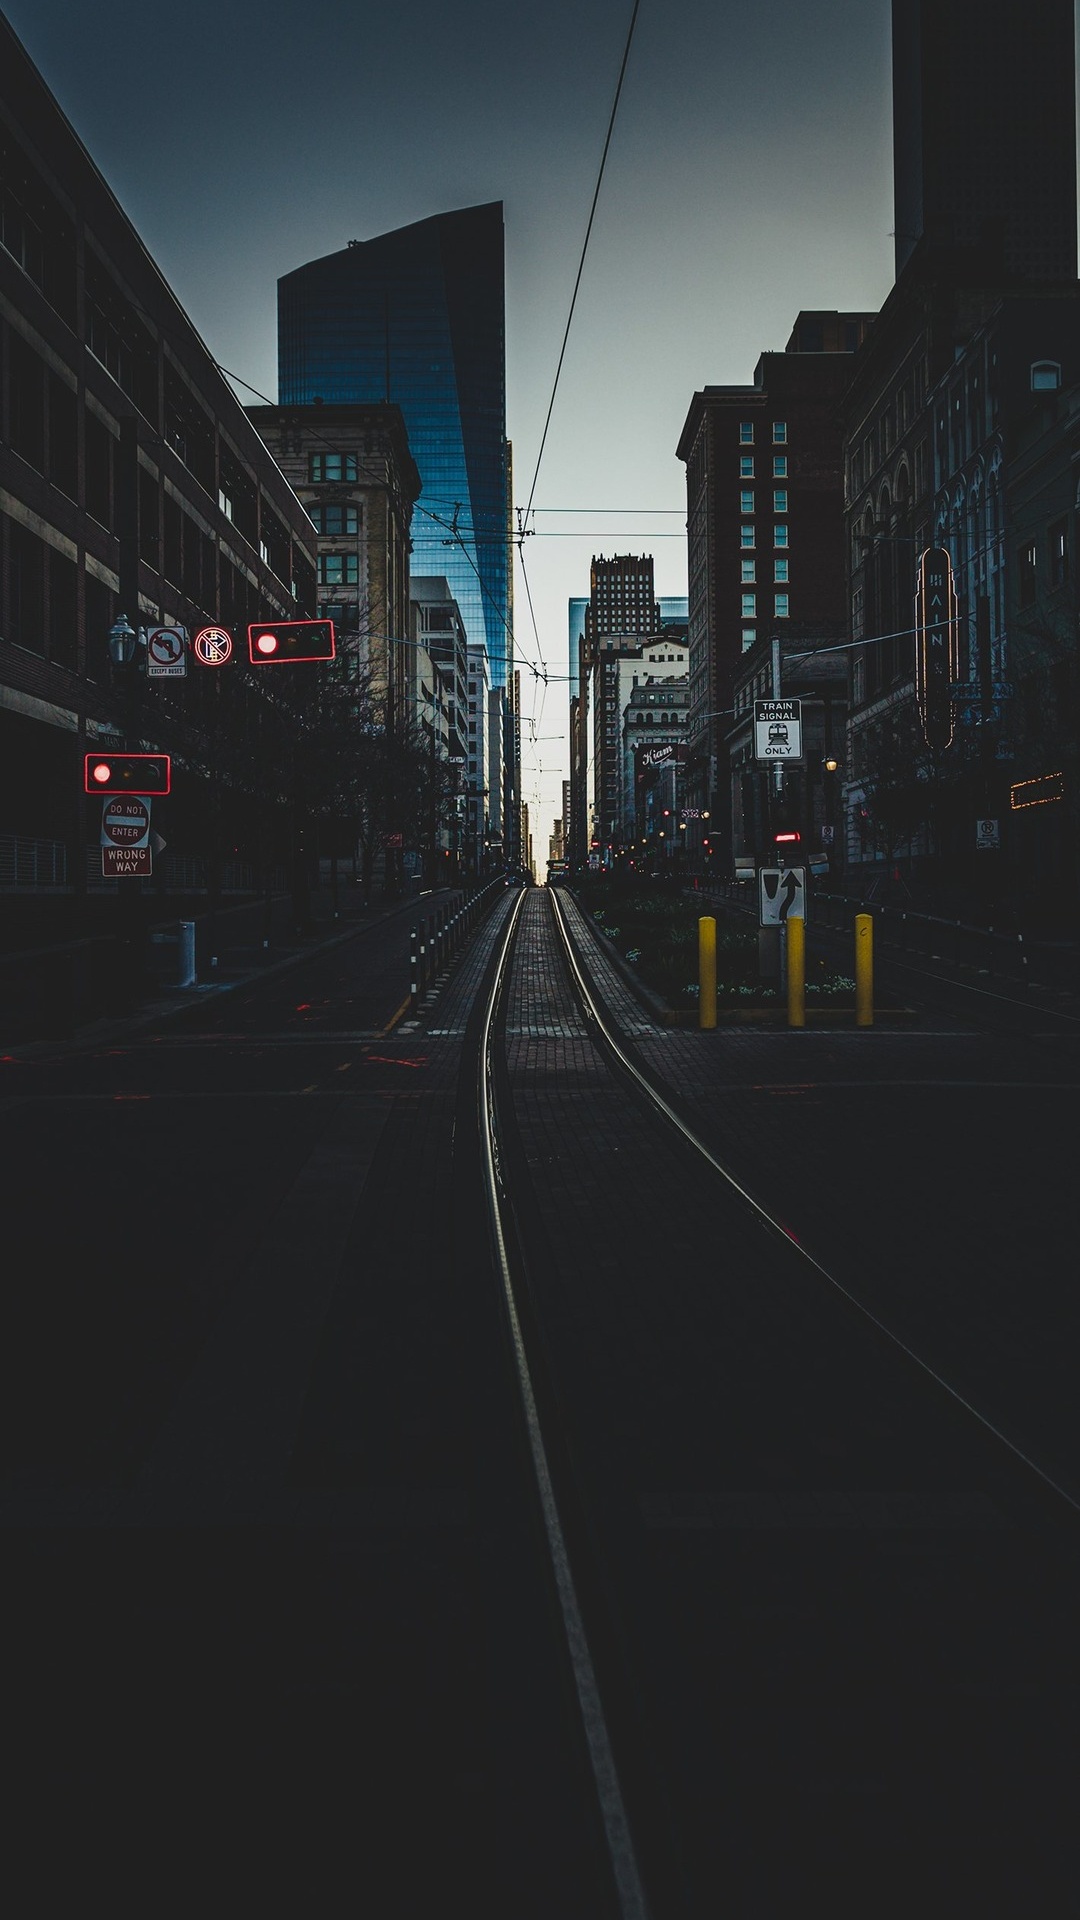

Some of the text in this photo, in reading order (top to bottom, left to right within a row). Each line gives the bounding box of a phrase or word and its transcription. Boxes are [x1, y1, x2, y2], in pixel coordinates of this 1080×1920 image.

[762, 702, 793, 710] TRAIN
[759, 712, 797, 720] SIGNAL
[642, 745, 674, 766] Kiam
[765, 747, 792, 755] ONLY
[111, 805, 143, 815] DO NOT
[112, 827, 139, 837] ENTER
[108, 849, 146, 860] WRONG
[116, 861, 138, 872] WAY
